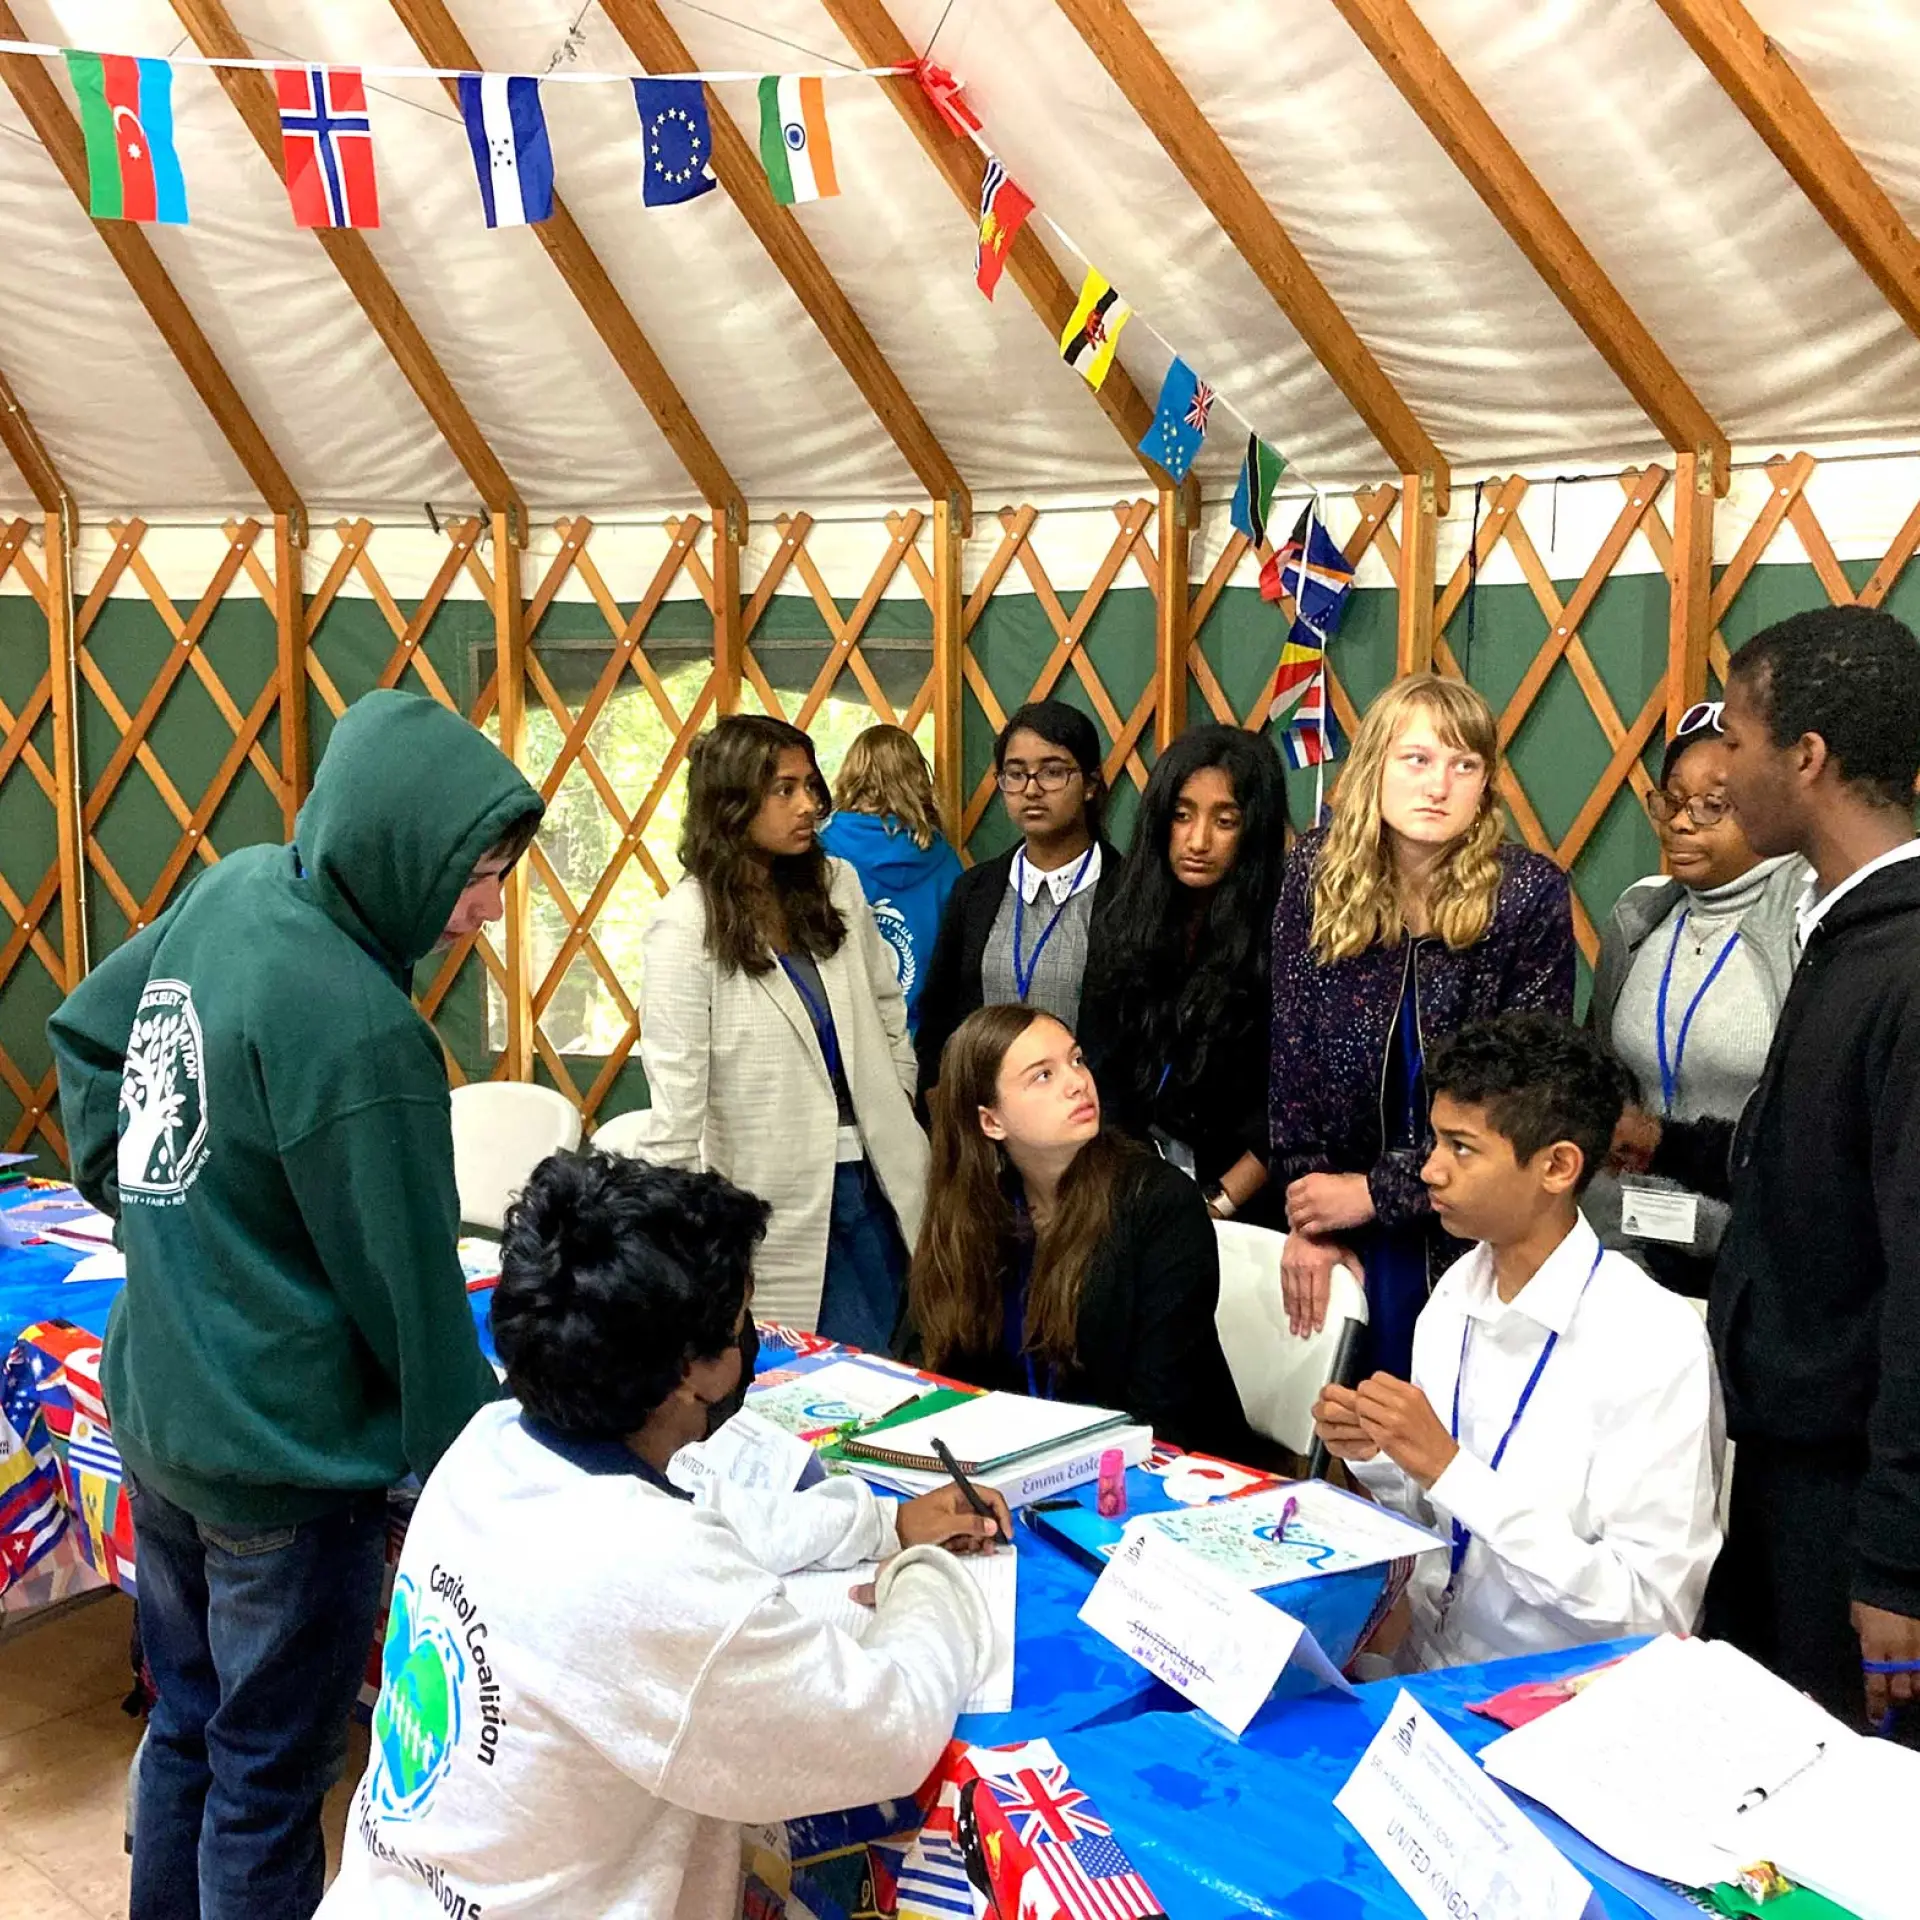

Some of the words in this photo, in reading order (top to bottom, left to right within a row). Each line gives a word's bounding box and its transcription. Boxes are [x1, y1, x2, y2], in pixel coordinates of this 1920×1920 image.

[673, 1452, 706, 1477] UNITED
[1022, 1471, 1066, 1496] Emma
[430, 1564, 477, 1626] Capitol
[465, 1622, 508, 1767] Coalition
[1387, 1815, 1431, 1874] UNITED
[402, 1854, 483, 1920] Nations
